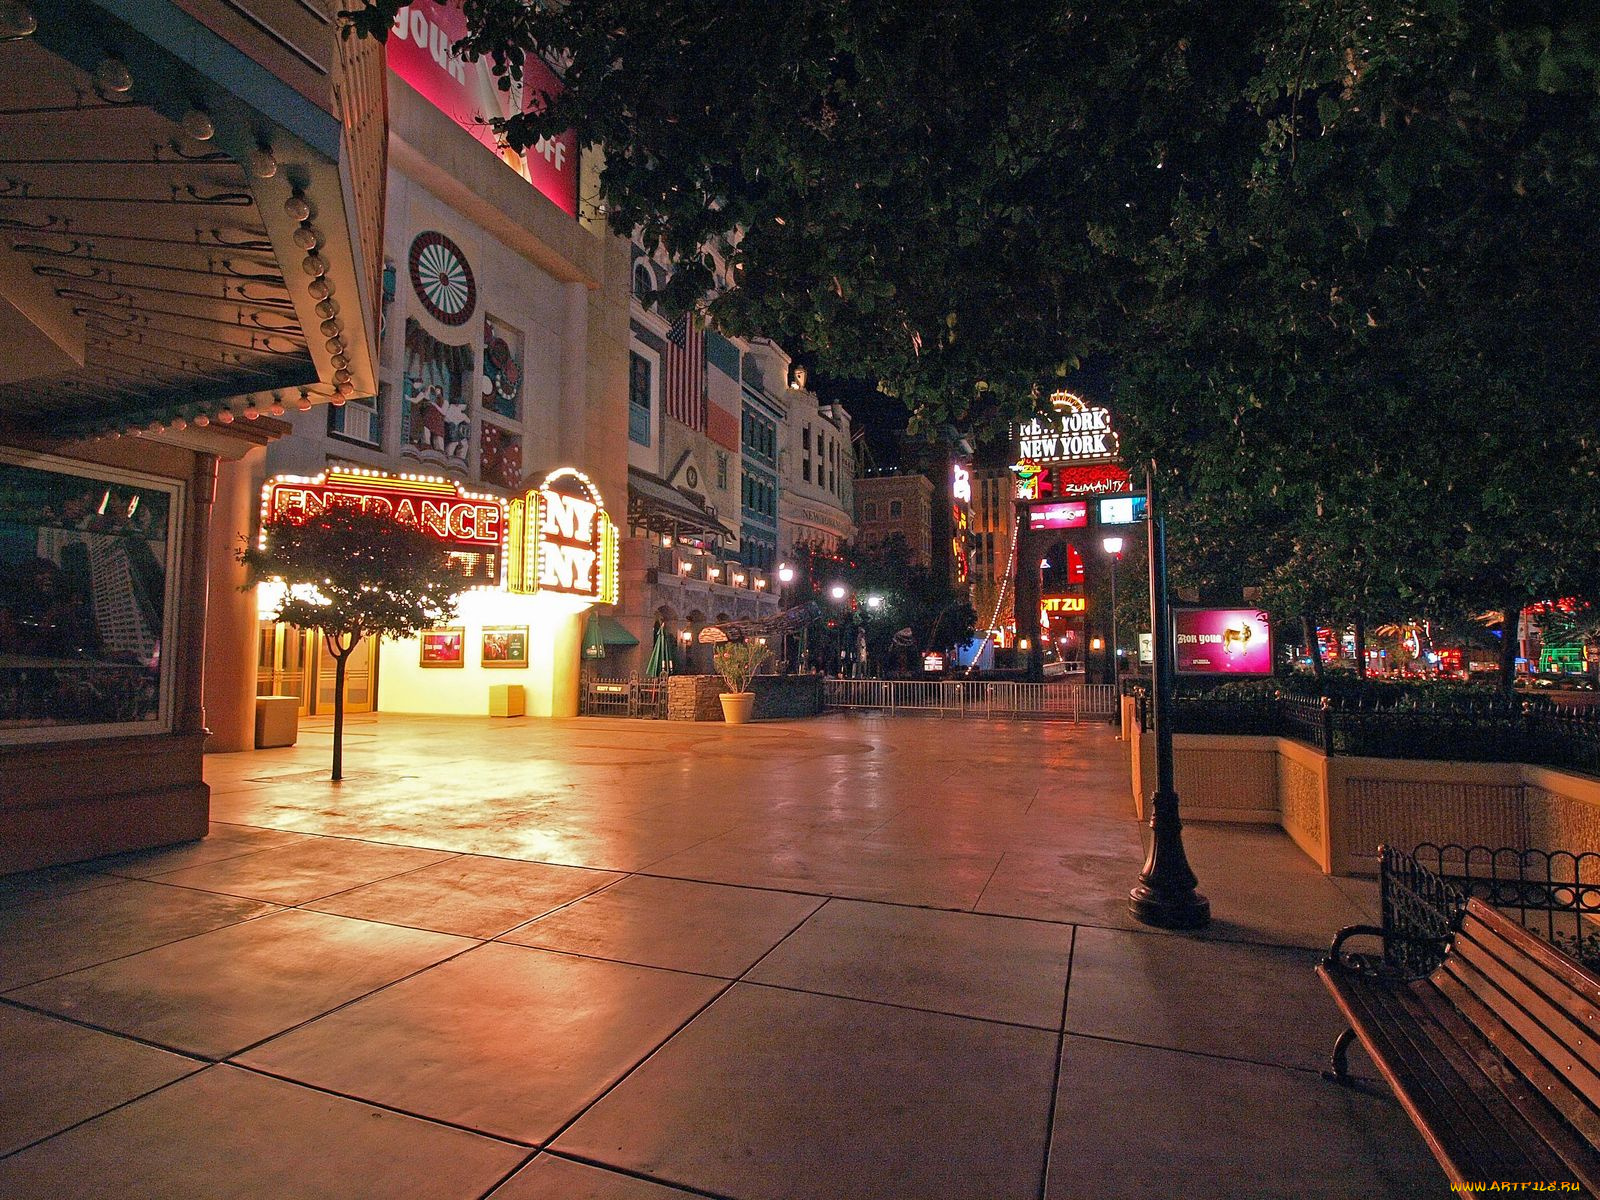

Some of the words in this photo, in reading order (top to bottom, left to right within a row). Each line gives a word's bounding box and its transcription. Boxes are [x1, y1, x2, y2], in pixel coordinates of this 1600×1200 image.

[1020, 438, 1058, 459] NEW
[1060, 434, 1108, 455] YORK
[541, 490, 597, 542] NY
[539, 541, 596, 592] NY
